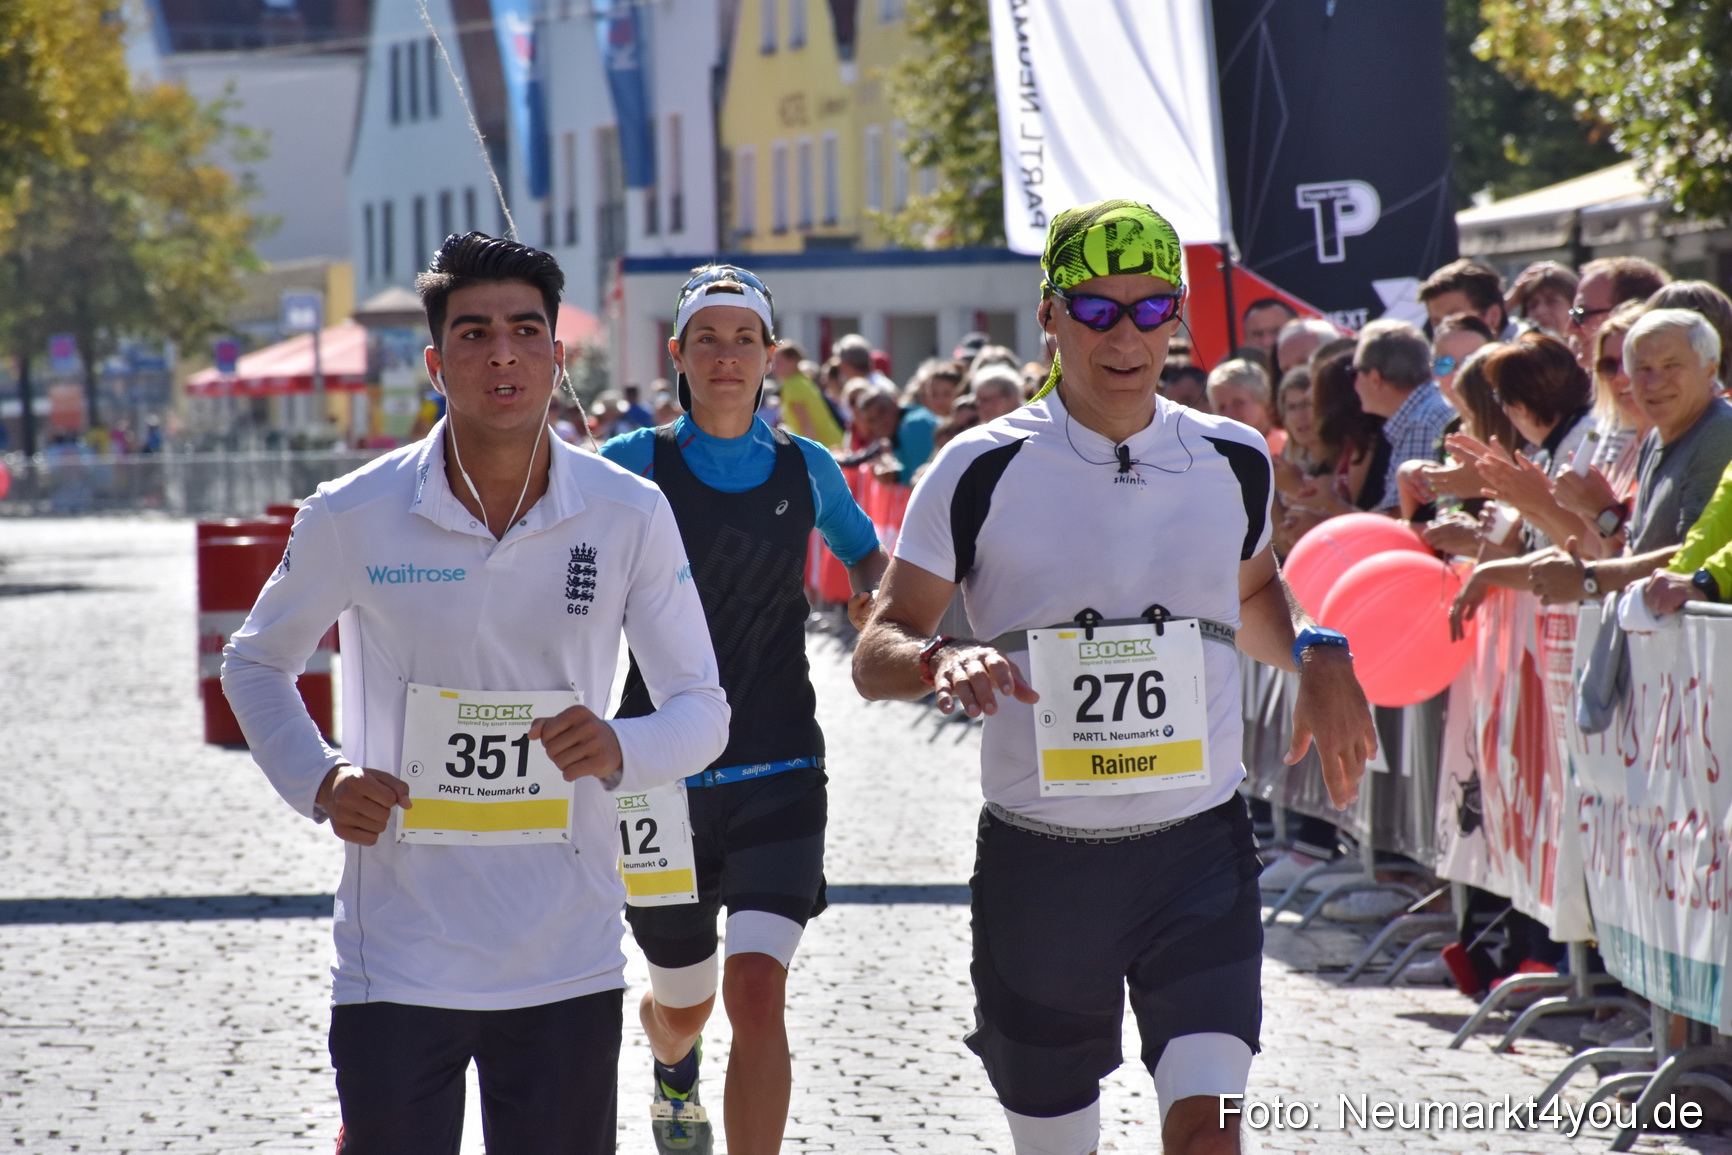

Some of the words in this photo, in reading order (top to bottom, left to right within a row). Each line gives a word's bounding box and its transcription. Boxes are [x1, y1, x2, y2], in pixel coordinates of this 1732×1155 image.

[365, 563, 466, 585] Waitrose
[567, 603, 589, 616] 665
[1199, 621, 1235, 639] THA
[1079, 638, 1155, 659] BOCK
[1132, 656, 1157, 664] concepts
[1073, 670, 1167, 723] 276
[458, 703, 533, 720] BOCK
[457, 719, 483, 727] inspired
[508, 719, 532, 727] concept
[1073, 731, 1107, 741] PARTL
[1109, 729, 1159, 741] Neumarkt
[446, 733, 530, 780] 351
[1091, 754, 1157, 775] Rainer
[742, 763, 771, 776] sailfish
[438, 784, 475, 796] PARTL
[477, 786, 525, 796] Neumarkt
[616, 794, 649, 809] CK
[619, 817, 660, 855] 12
